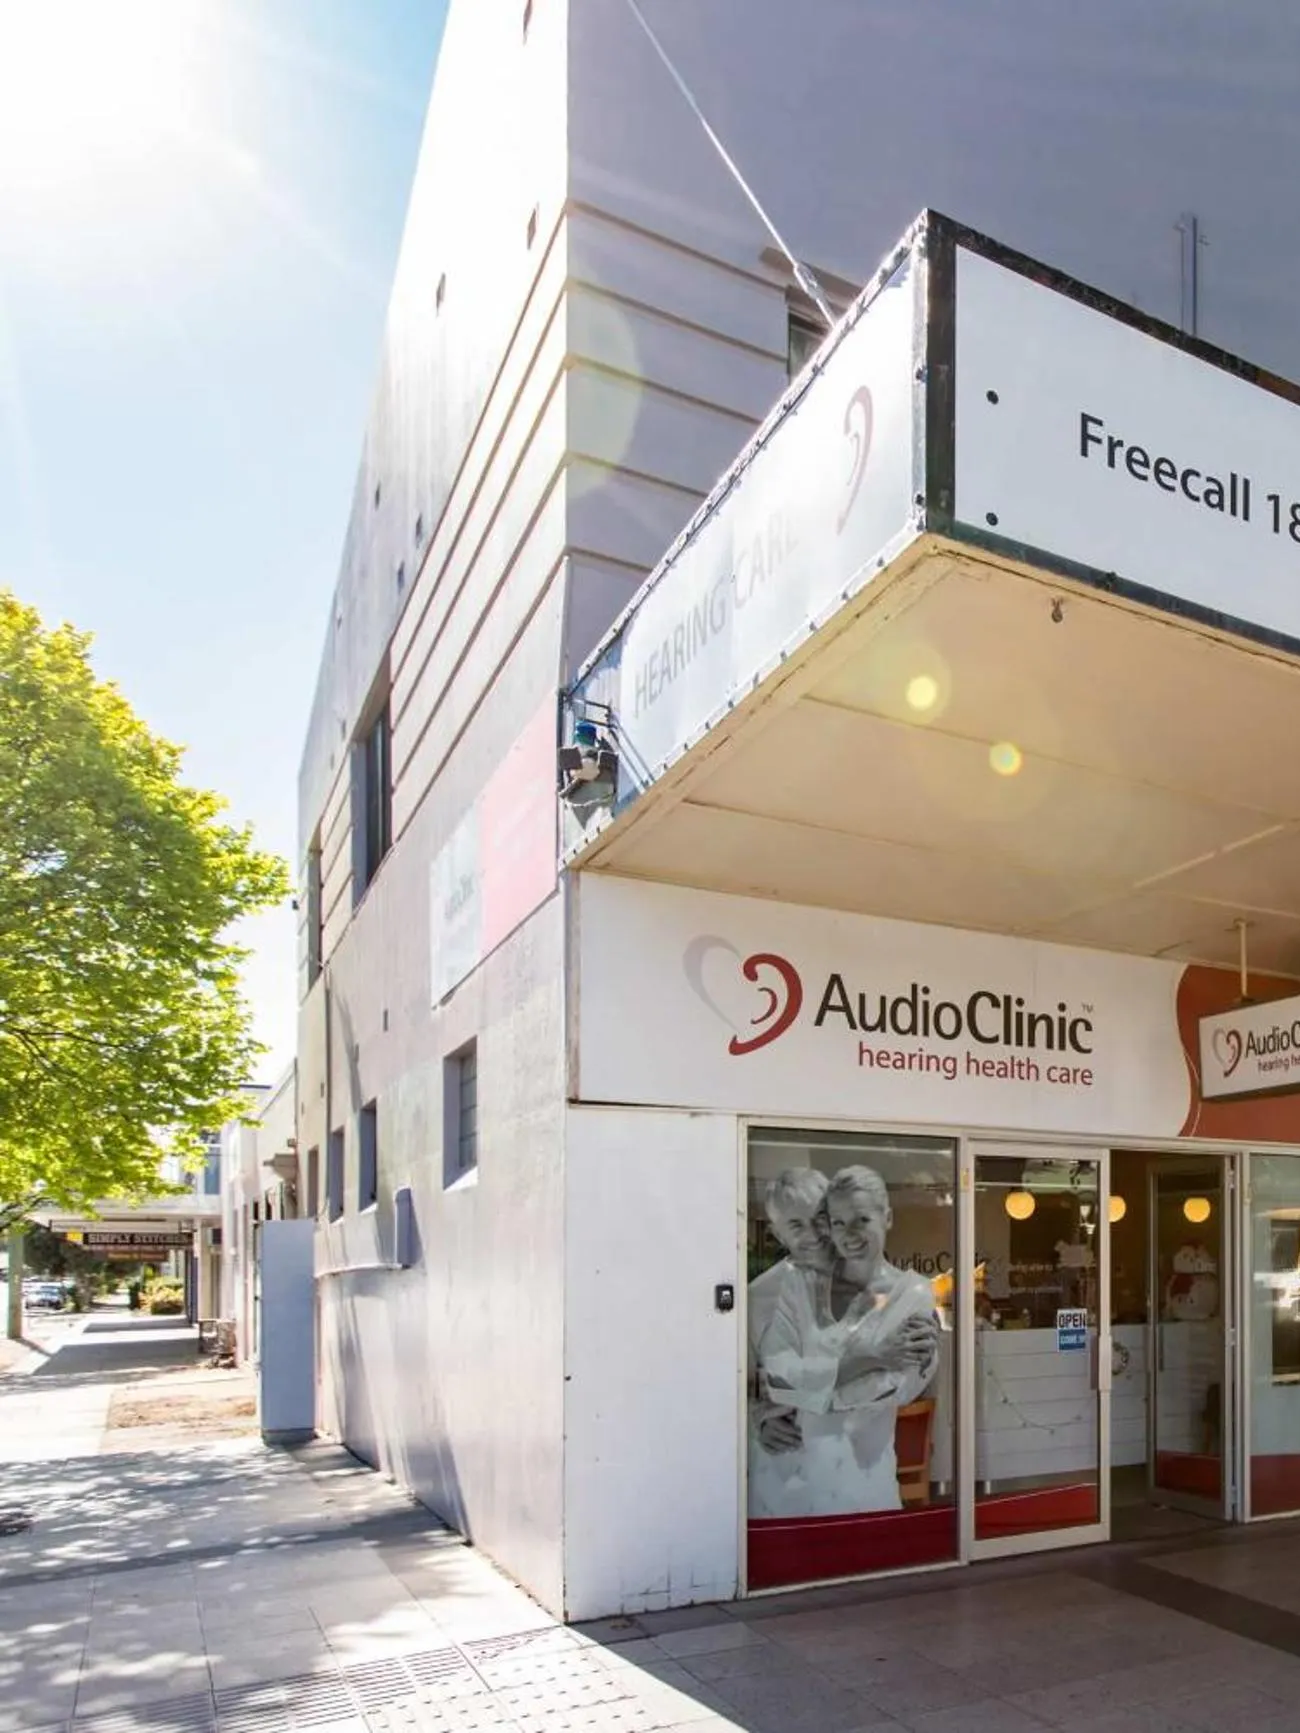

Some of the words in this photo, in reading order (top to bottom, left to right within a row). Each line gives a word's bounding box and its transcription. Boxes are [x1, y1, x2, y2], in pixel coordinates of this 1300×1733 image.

[1079, 411, 1251, 521] Freecall
[633, 575, 727, 719] HEARING
[813, 972, 1094, 1055] AudioClinic
[858, 1041, 958, 1081] hearing
[965, 1051, 1040, 1082] health
[1045, 1063, 1094, 1086] care
[1257, 1053, 1290, 1073] hearing
[87, 1233, 131, 1244] SIMPLY
[1058, 1313, 1087, 1329] OPEN
